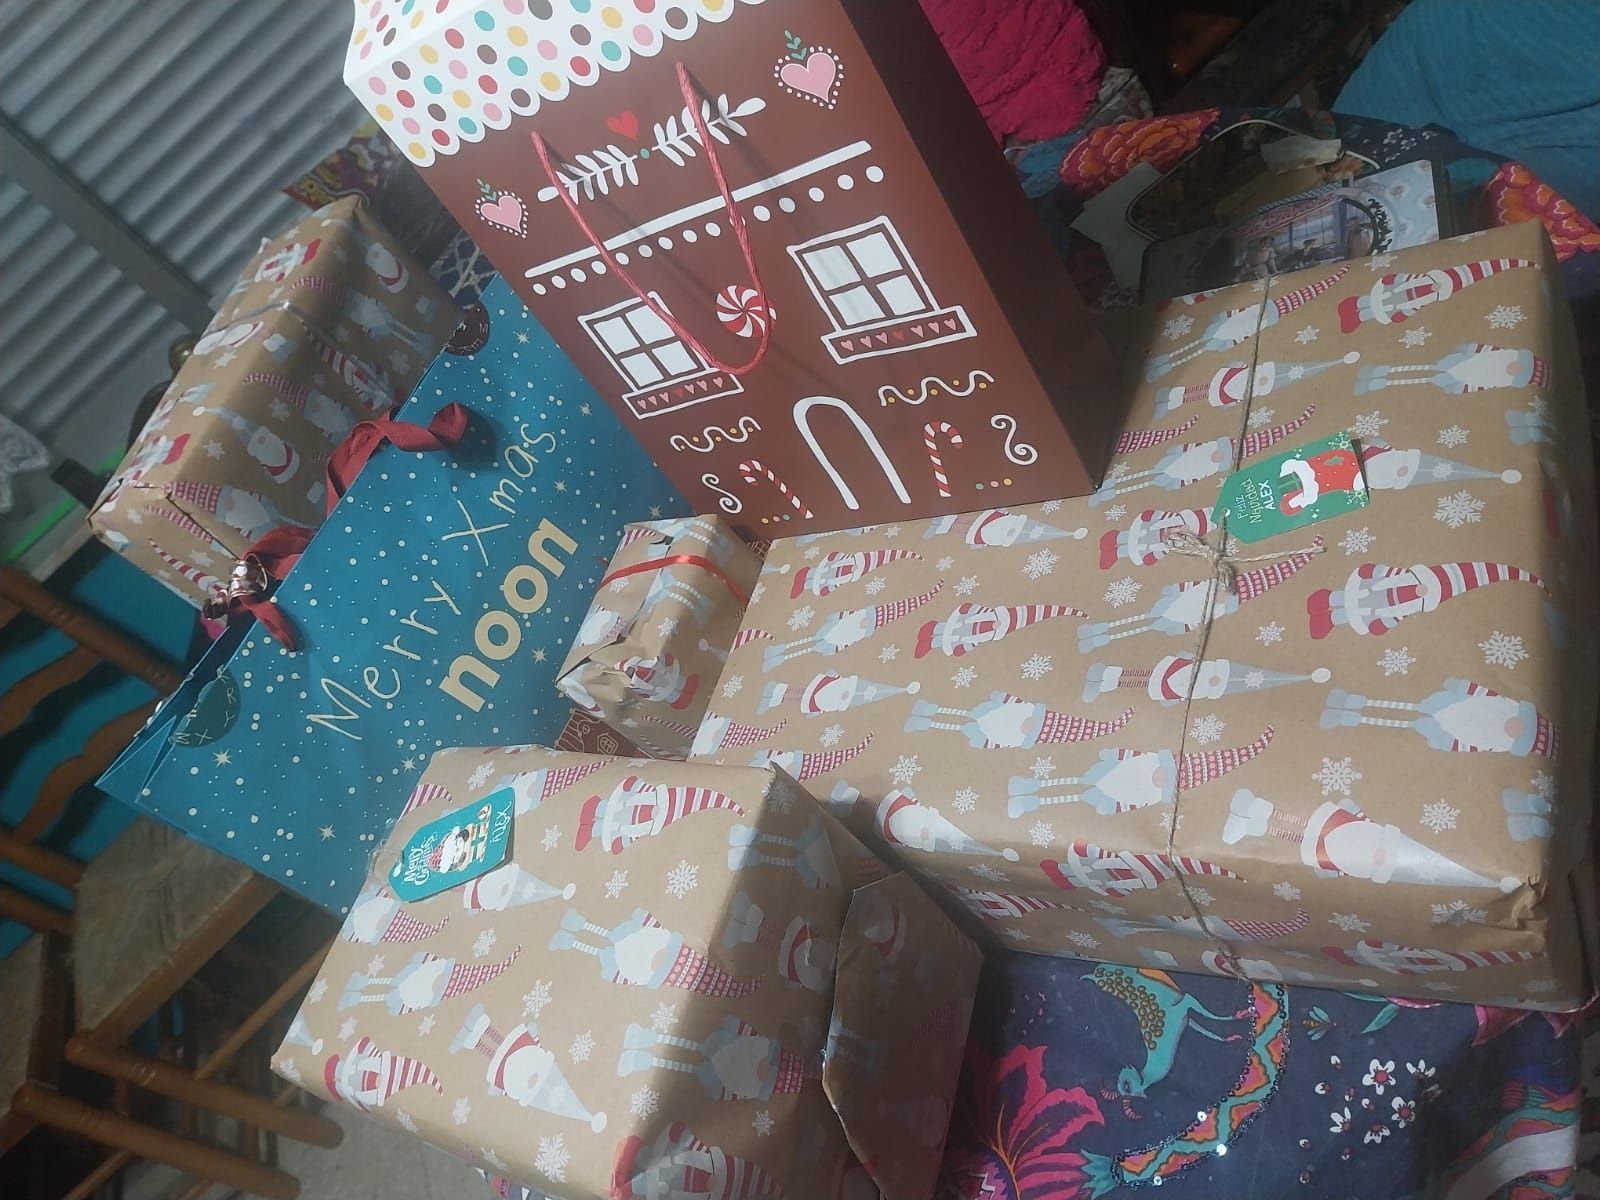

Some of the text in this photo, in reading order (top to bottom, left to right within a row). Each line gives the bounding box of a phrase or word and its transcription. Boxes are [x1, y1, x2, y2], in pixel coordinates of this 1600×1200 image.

[1236, 494, 1250, 520] Feliz
[1240, 477, 1263, 524] Navidad
[439, 517, 579, 713] noon
[306, 580, 461, 741] Merry
[404, 846, 424, 883] Merry
